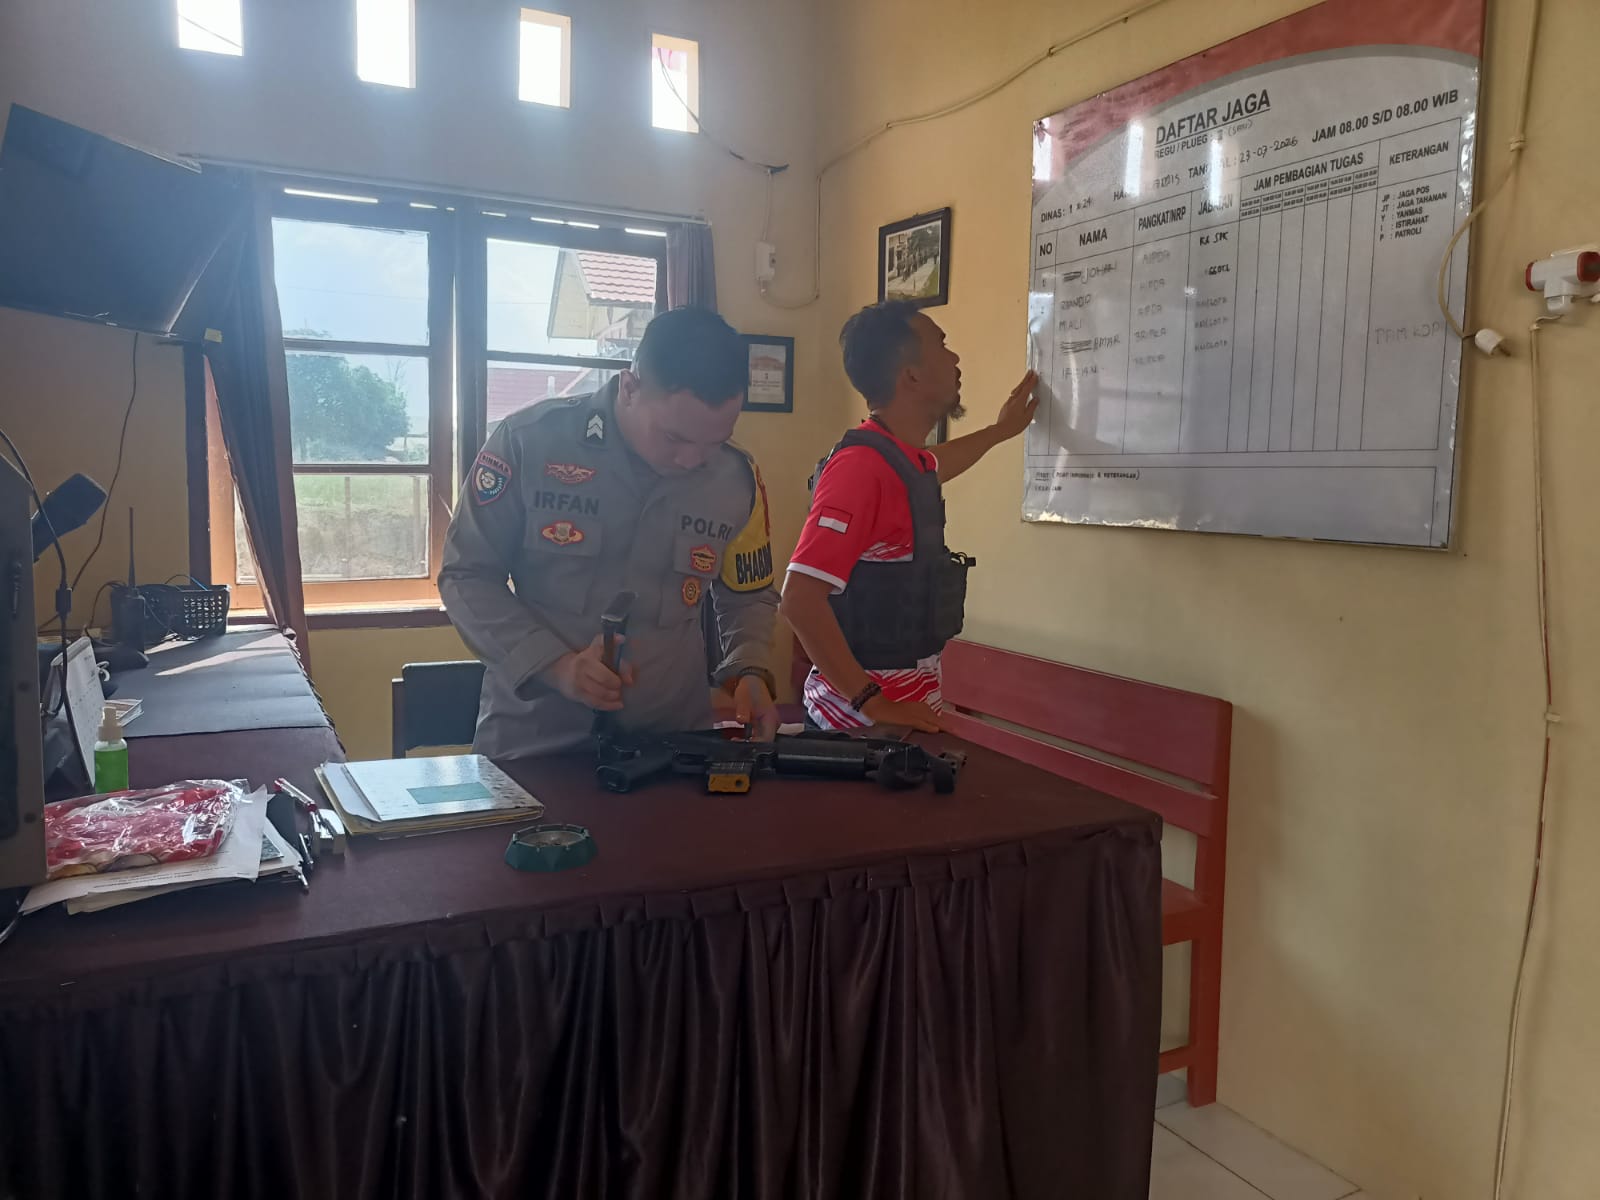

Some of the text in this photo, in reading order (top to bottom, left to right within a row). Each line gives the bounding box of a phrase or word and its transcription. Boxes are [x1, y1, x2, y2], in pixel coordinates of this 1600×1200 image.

[1155, 89, 1271, 145] DAFTAR JAGA
[1312, 89, 1459, 144] JAM 08.00 S/D 08.00 WIB
[1155, 145, 1176, 160] REGU
[1389, 140, 1449, 166] KETERANGAN
[1254, 177, 1272, 192] JAM
[1274, 164, 1328, 187] PEMBAGIAN
[1330, 151, 1364, 172] TUGAS
[1396, 198, 1415, 209] JAGA
[1416, 191, 1448, 205] TAHANAN
[1397, 188, 1415, 199] JAGA
[1416, 185, 1430, 195] POS
[1395, 214, 1429, 229] ISTIRAHAT
[1079, 227, 1108, 247] NAMA
[1394, 226, 1422, 239] PATROLI
[1039, 242, 1053, 257] NO
[534, 489, 600, 517] IRFAN
[680, 513, 733, 541] POLRI
